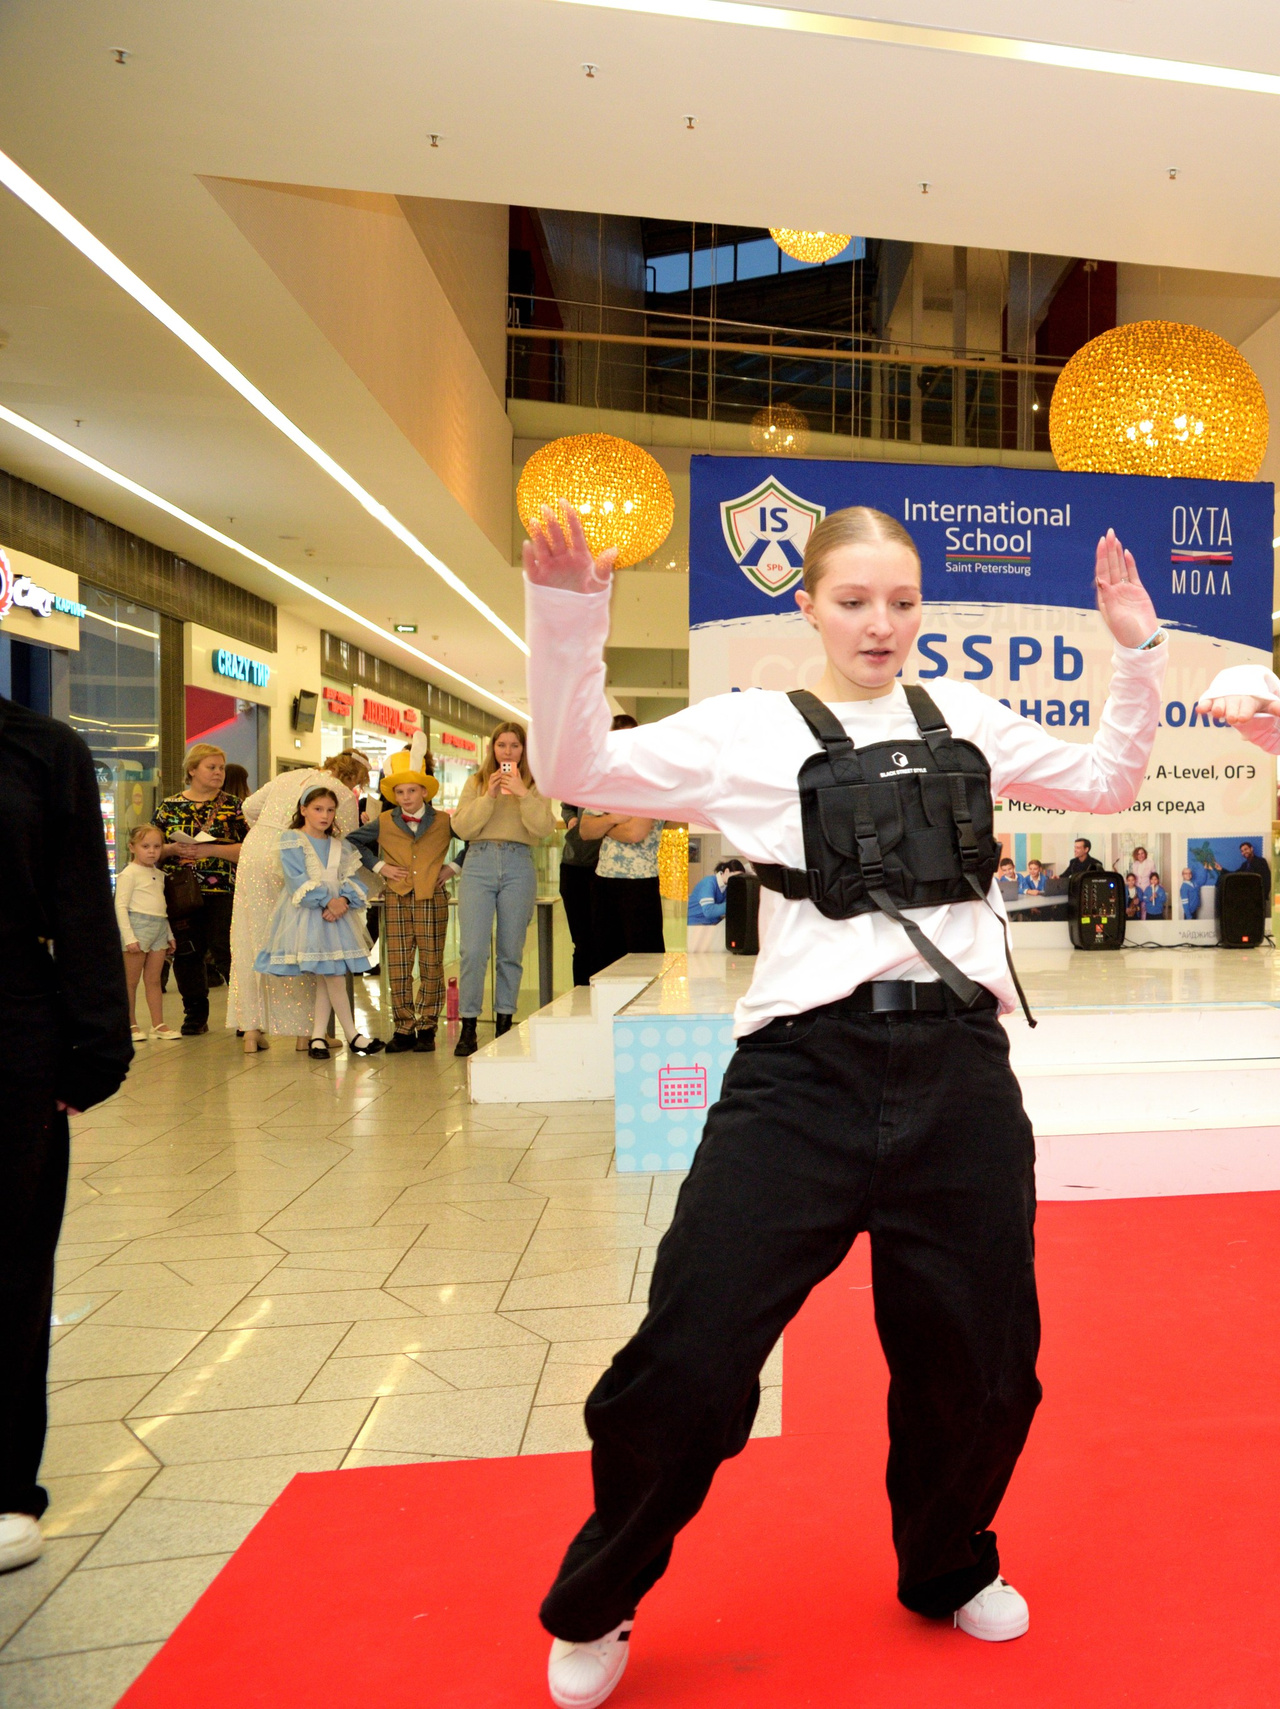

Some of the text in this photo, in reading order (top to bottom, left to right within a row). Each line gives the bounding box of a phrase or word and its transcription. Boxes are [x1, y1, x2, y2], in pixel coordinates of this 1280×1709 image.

[759, 506, 789, 533] IS
[904, 498, 1071, 527] International
[1172, 505, 1233, 546] ОХТА
[945, 527, 1032, 553] School
[766, 563, 783, 571] SPb
[945, 561, 1031, 577] Saint Petersburg
[1172, 569, 1231, 595] МОЛЛ
[217, 648, 271, 688] CRAZY ТИР
[894, 633, 1084, 681] SSPb
[1155, 764, 1219, 781] A-Level,
[1223, 764, 1256, 779] ОГЭ
[1157, 800, 1206, 815] среда
